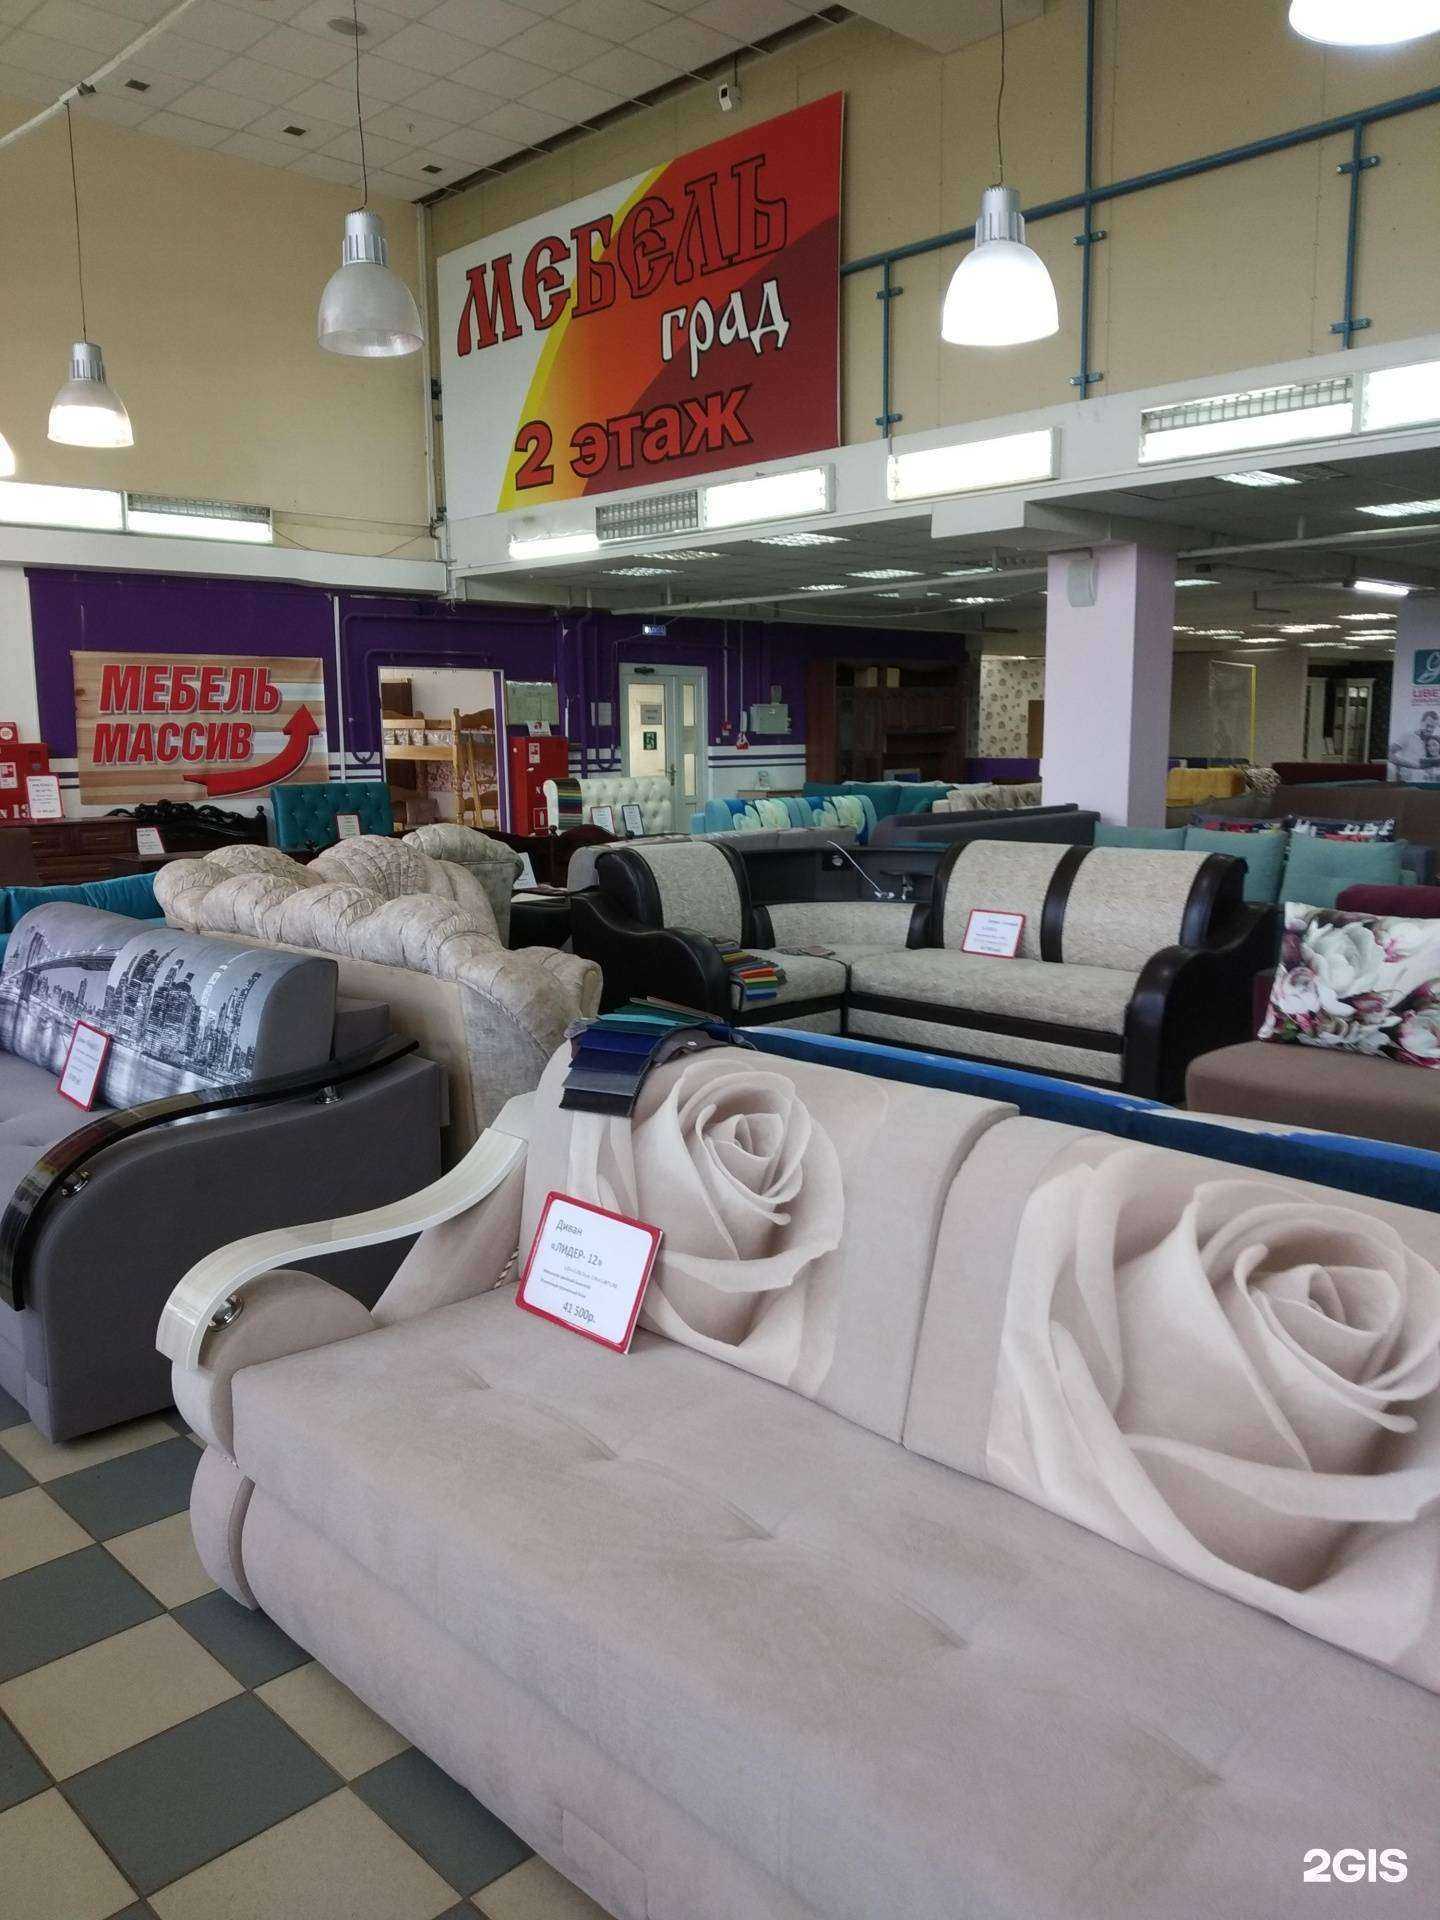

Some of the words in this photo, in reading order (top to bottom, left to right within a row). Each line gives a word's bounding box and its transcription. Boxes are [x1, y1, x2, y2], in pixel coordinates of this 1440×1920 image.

[457, 153, 787, 358] МЕБЕЛЬ
[660, 279, 790, 379] град
[515, 420, 554, 491] 2
[569, 383, 754, 479] этаж
[99, 663, 283, 716] МЕБЕЛЬ
[92, 721, 254, 765] МАССИВ
[556, 1219, 583, 1237] Диван
